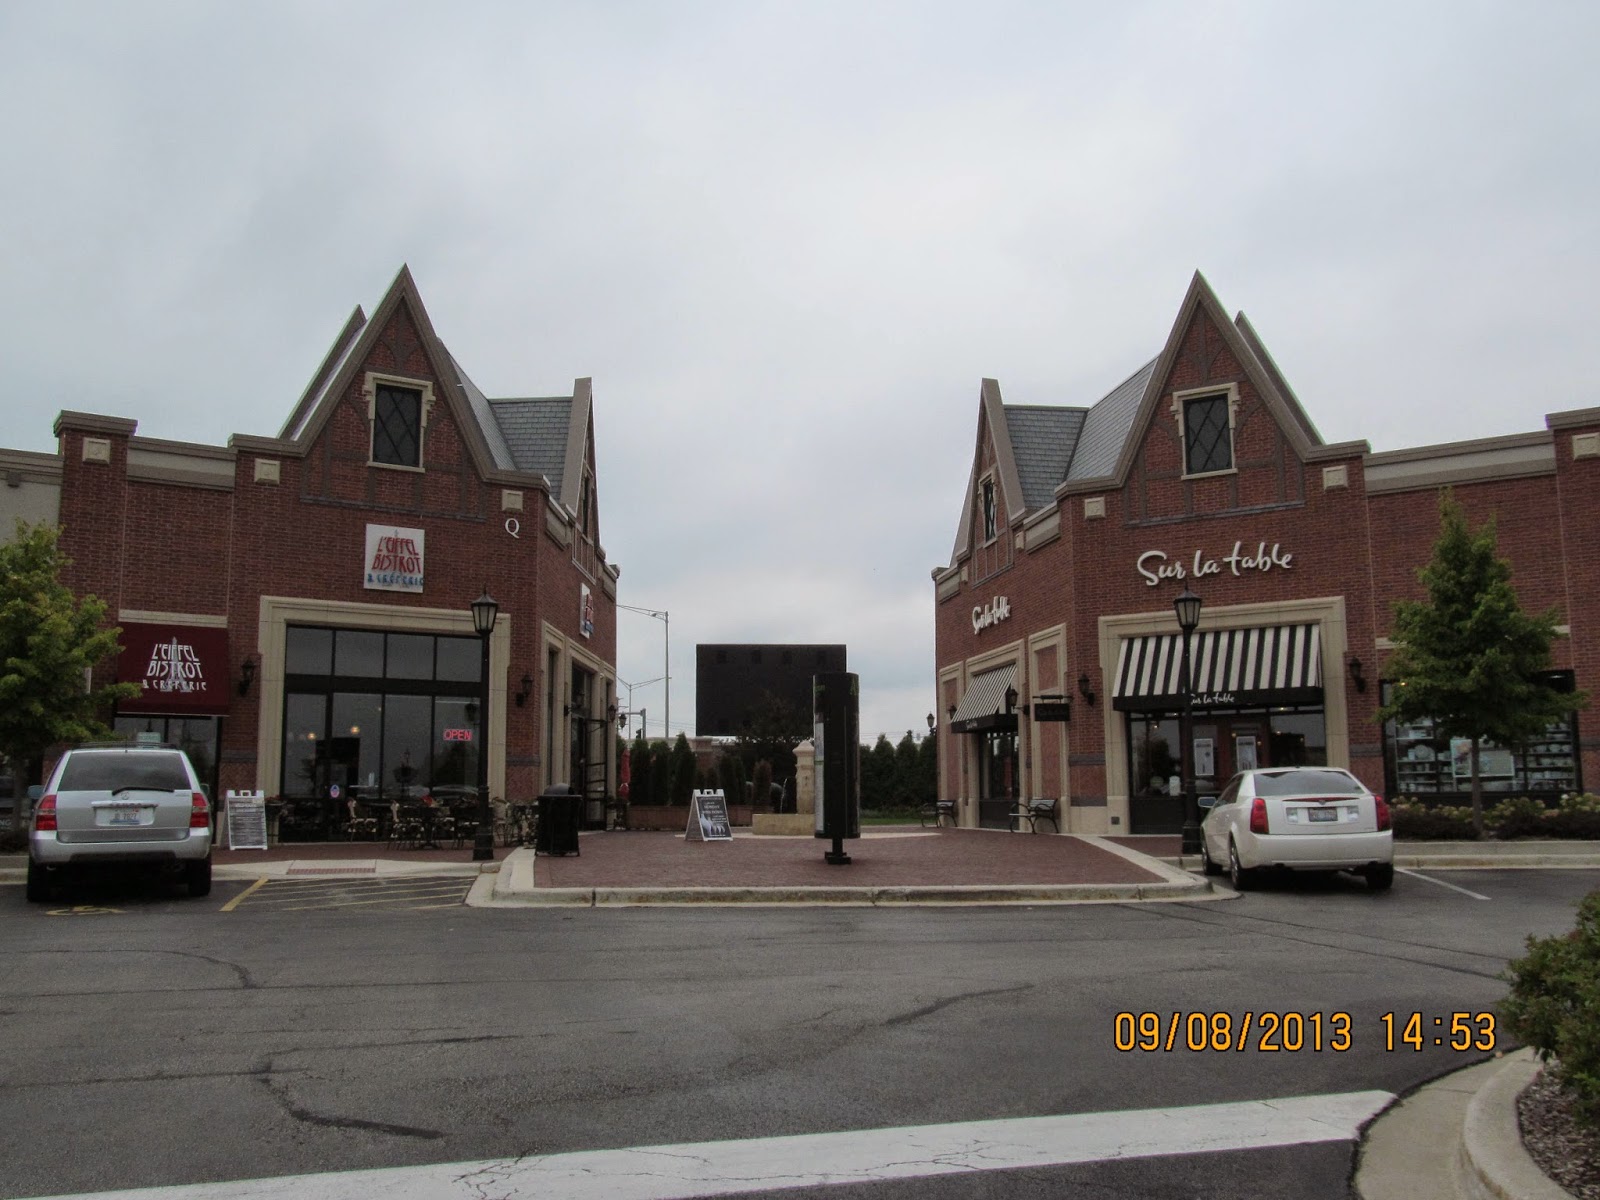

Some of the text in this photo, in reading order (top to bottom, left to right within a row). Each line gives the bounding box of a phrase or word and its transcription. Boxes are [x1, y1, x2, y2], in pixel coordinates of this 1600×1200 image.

[504, 517, 520, 539] Q
[377, 536, 420, 556] L'EIFFEL
[371, 553, 422, 574] BISTROT
[1136, 540, 1293, 586] Sur la table
[151, 643, 200, 662] L'EIFFEL
[146, 660, 203, 679] BISTROT
[444, 729, 471, 741] OPEN
